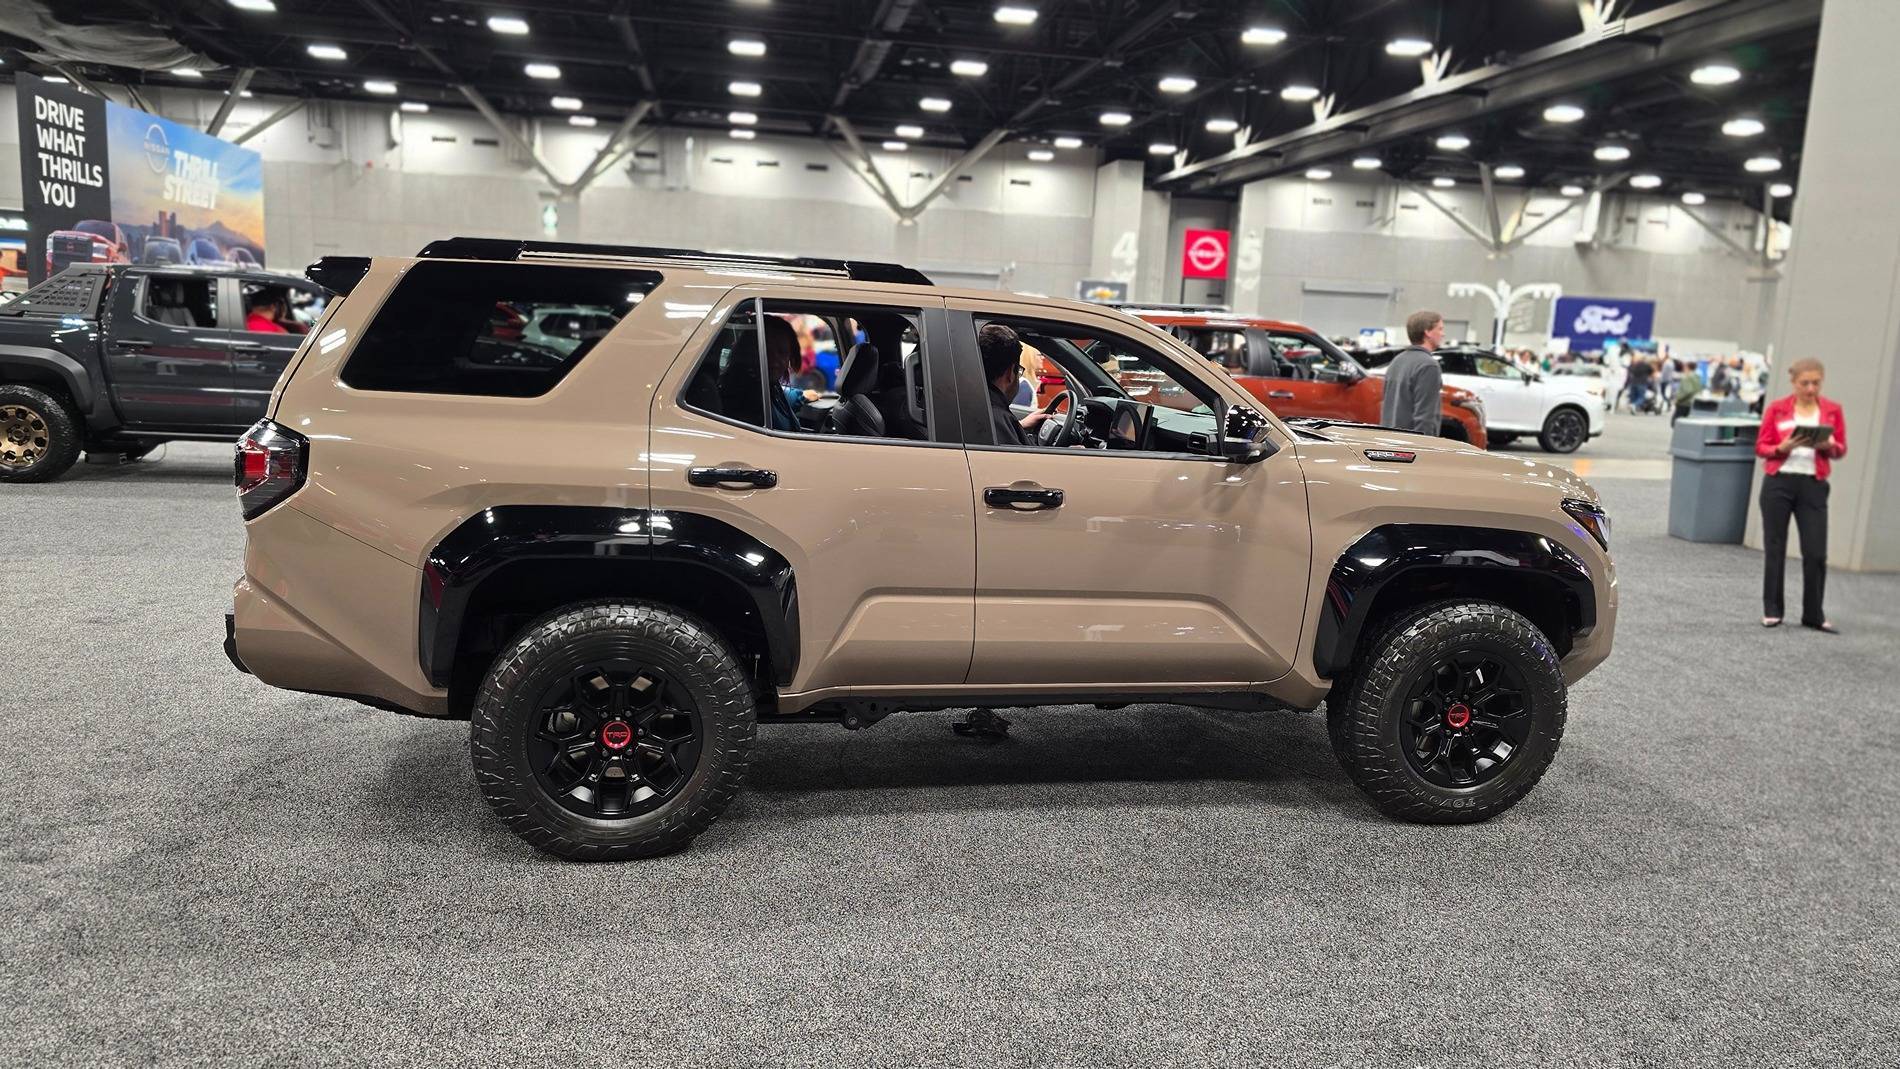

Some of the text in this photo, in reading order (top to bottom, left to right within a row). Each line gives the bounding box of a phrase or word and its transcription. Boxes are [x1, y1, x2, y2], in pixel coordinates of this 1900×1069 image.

[35, 95, 85, 132] DRIVE
[36, 123, 86, 158] WHAT
[38, 152, 103, 188] THRILLS
[39, 180, 75, 208] YOU
[163, 174, 220, 210] STREET
[1112, 231, 1138, 266] 4
[1238, 237, 1261, 271] 5
[1573, 305, 1632, 335] Ford
